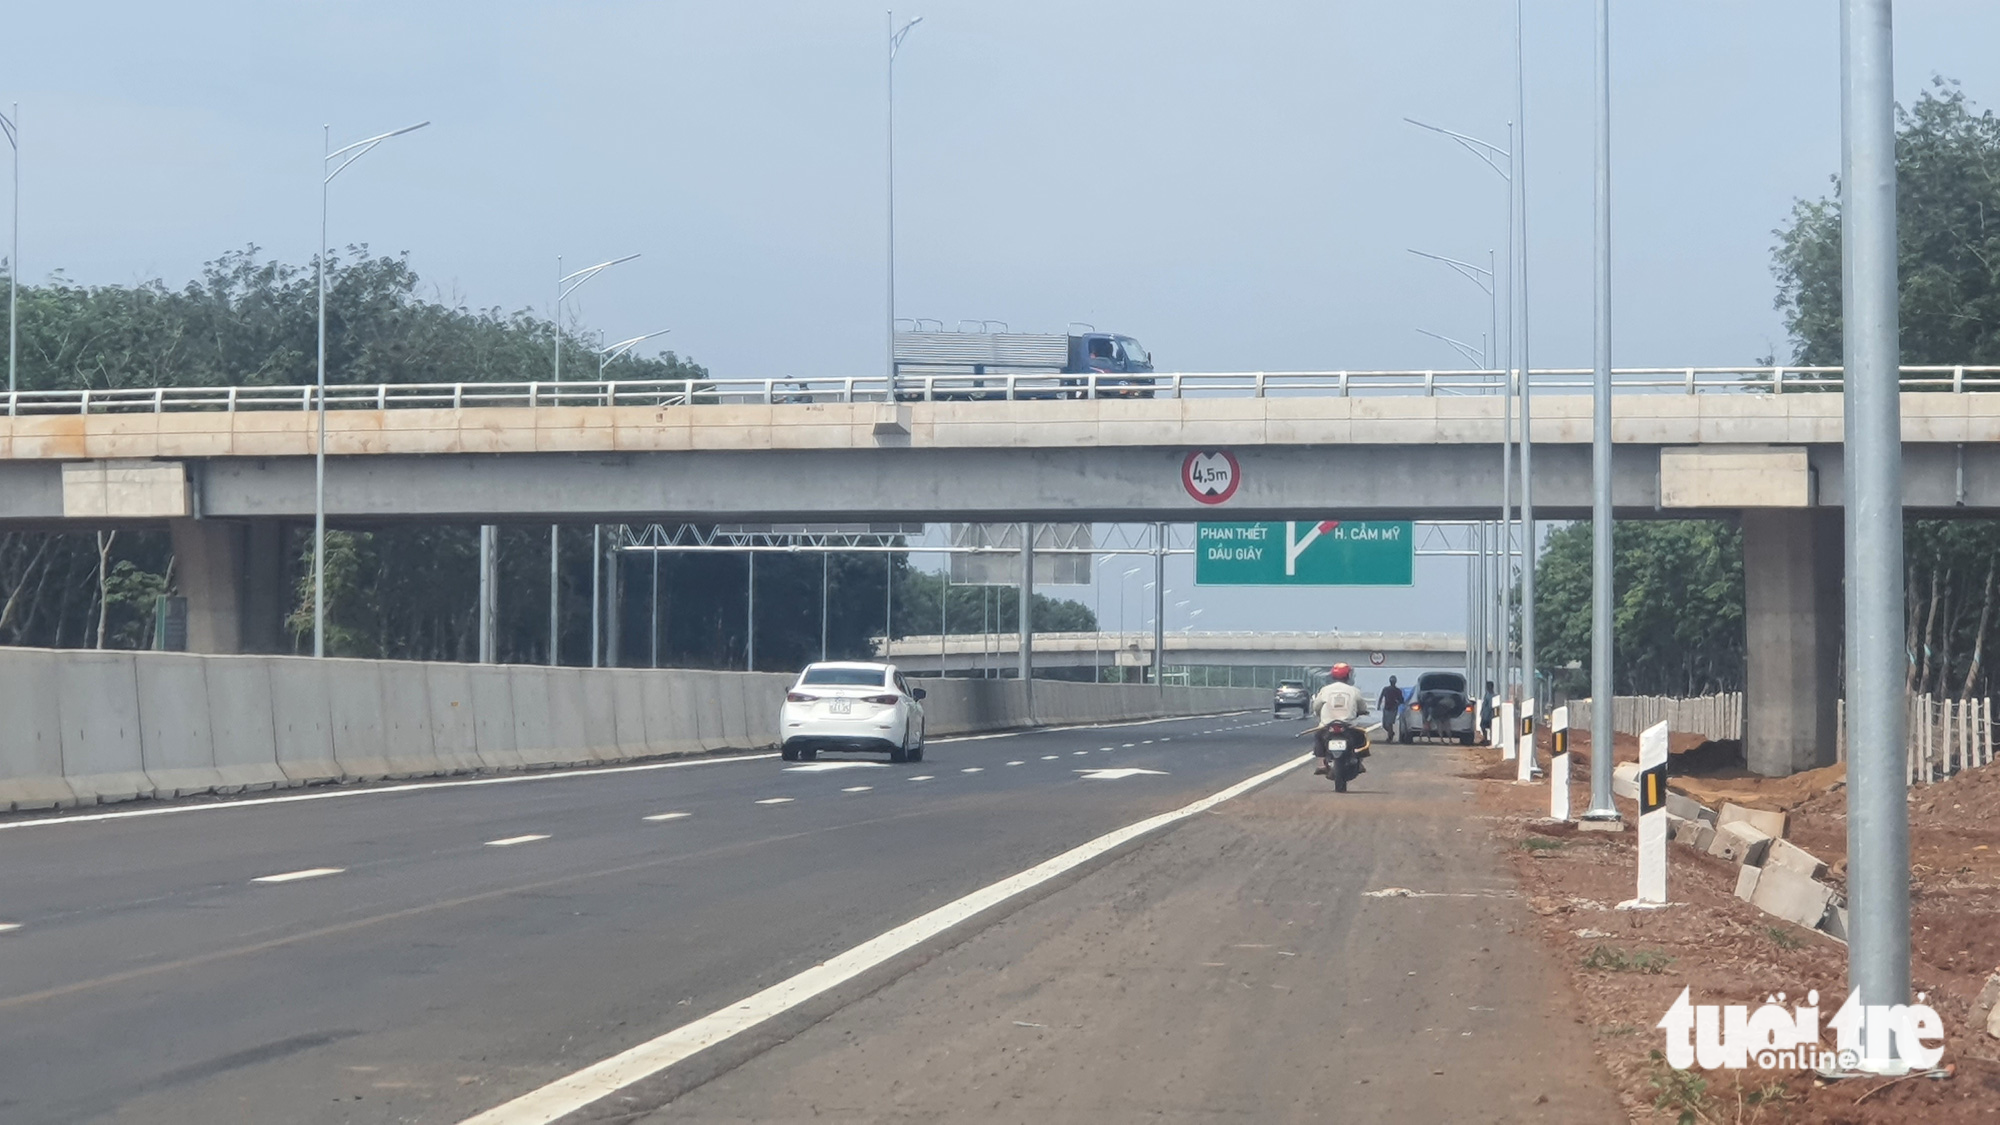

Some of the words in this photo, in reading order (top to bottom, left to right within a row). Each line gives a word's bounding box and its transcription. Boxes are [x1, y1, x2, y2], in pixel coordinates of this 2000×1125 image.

[1193, 460, 1228, 483] 4,5m
[1201, 527, 1233, 540] PHAN
[1235, 522, 1268, 540] THIẾT
[1334, 527, 1347, 540] H.
[1381, 525, 1401, 541] MỸ
[1235, 545, 1263, 560] GIÂY
